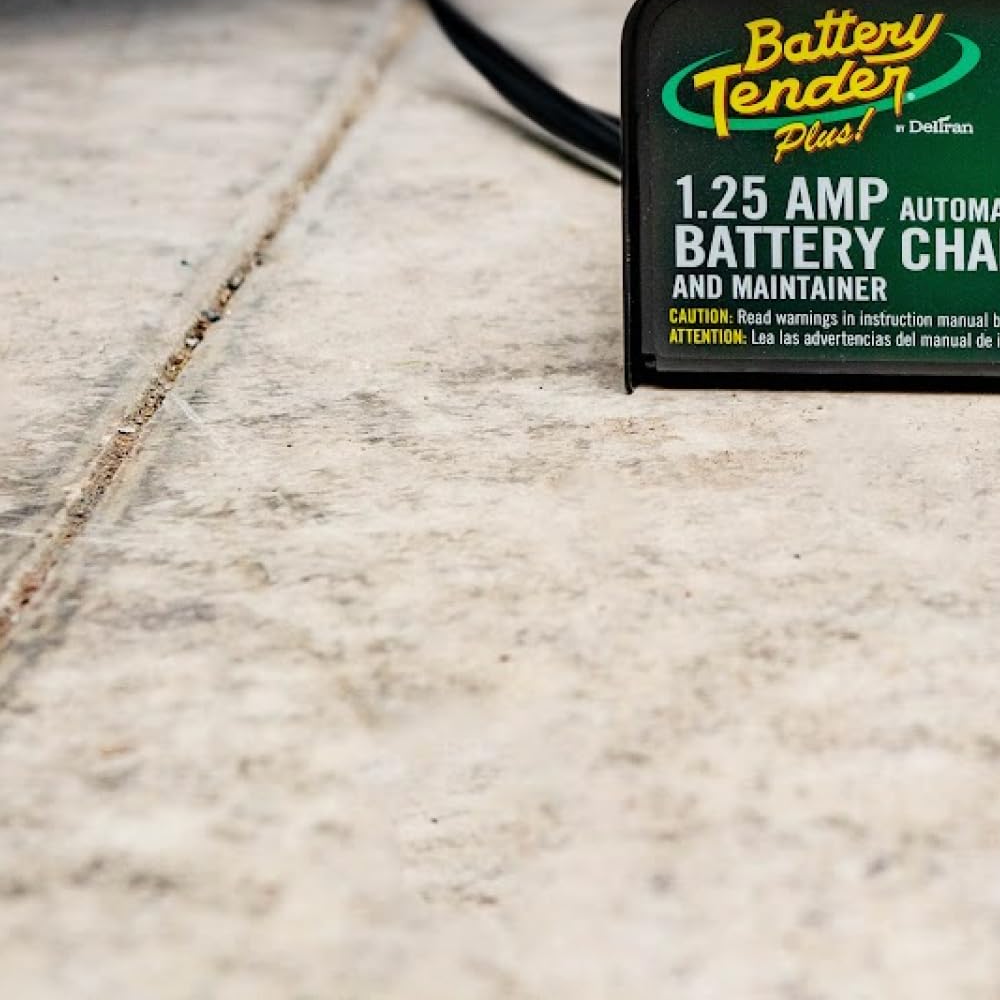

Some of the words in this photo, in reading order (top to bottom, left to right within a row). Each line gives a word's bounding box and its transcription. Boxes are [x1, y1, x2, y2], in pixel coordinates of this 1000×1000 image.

[744, 9, 945, 74] Battery
[693, 59, 911, 140] Tender
[773, 107, 877, 165] Plus!
[675, 174, 768, 220] 1.25
[785, 176, 889, 221] AMP
[674, 224, 886, 270] BATTERY
[672, 274, 723, 300] AND
[732, 275, 888, 302] MAINTAINER
[668, 308, 734, 325] CAUTION:
[737, 309, 772, 325] Read
[775, 310, 840, 330] warnings
[842, 310, 856, 326] in
[859, 310, 933, 327] instruction
[937, 312, 989, 328] manual
[668, 328, 748, 345] ATTENTION:
[751, 329, 775, 345] Lea
[779, 329, 800, 345] las
[803, 330, 892, 347] advertencias
[895, 331, 917, 347] del
[920, 331, 972, 348] manual
[976, 332, 993, 348] de
